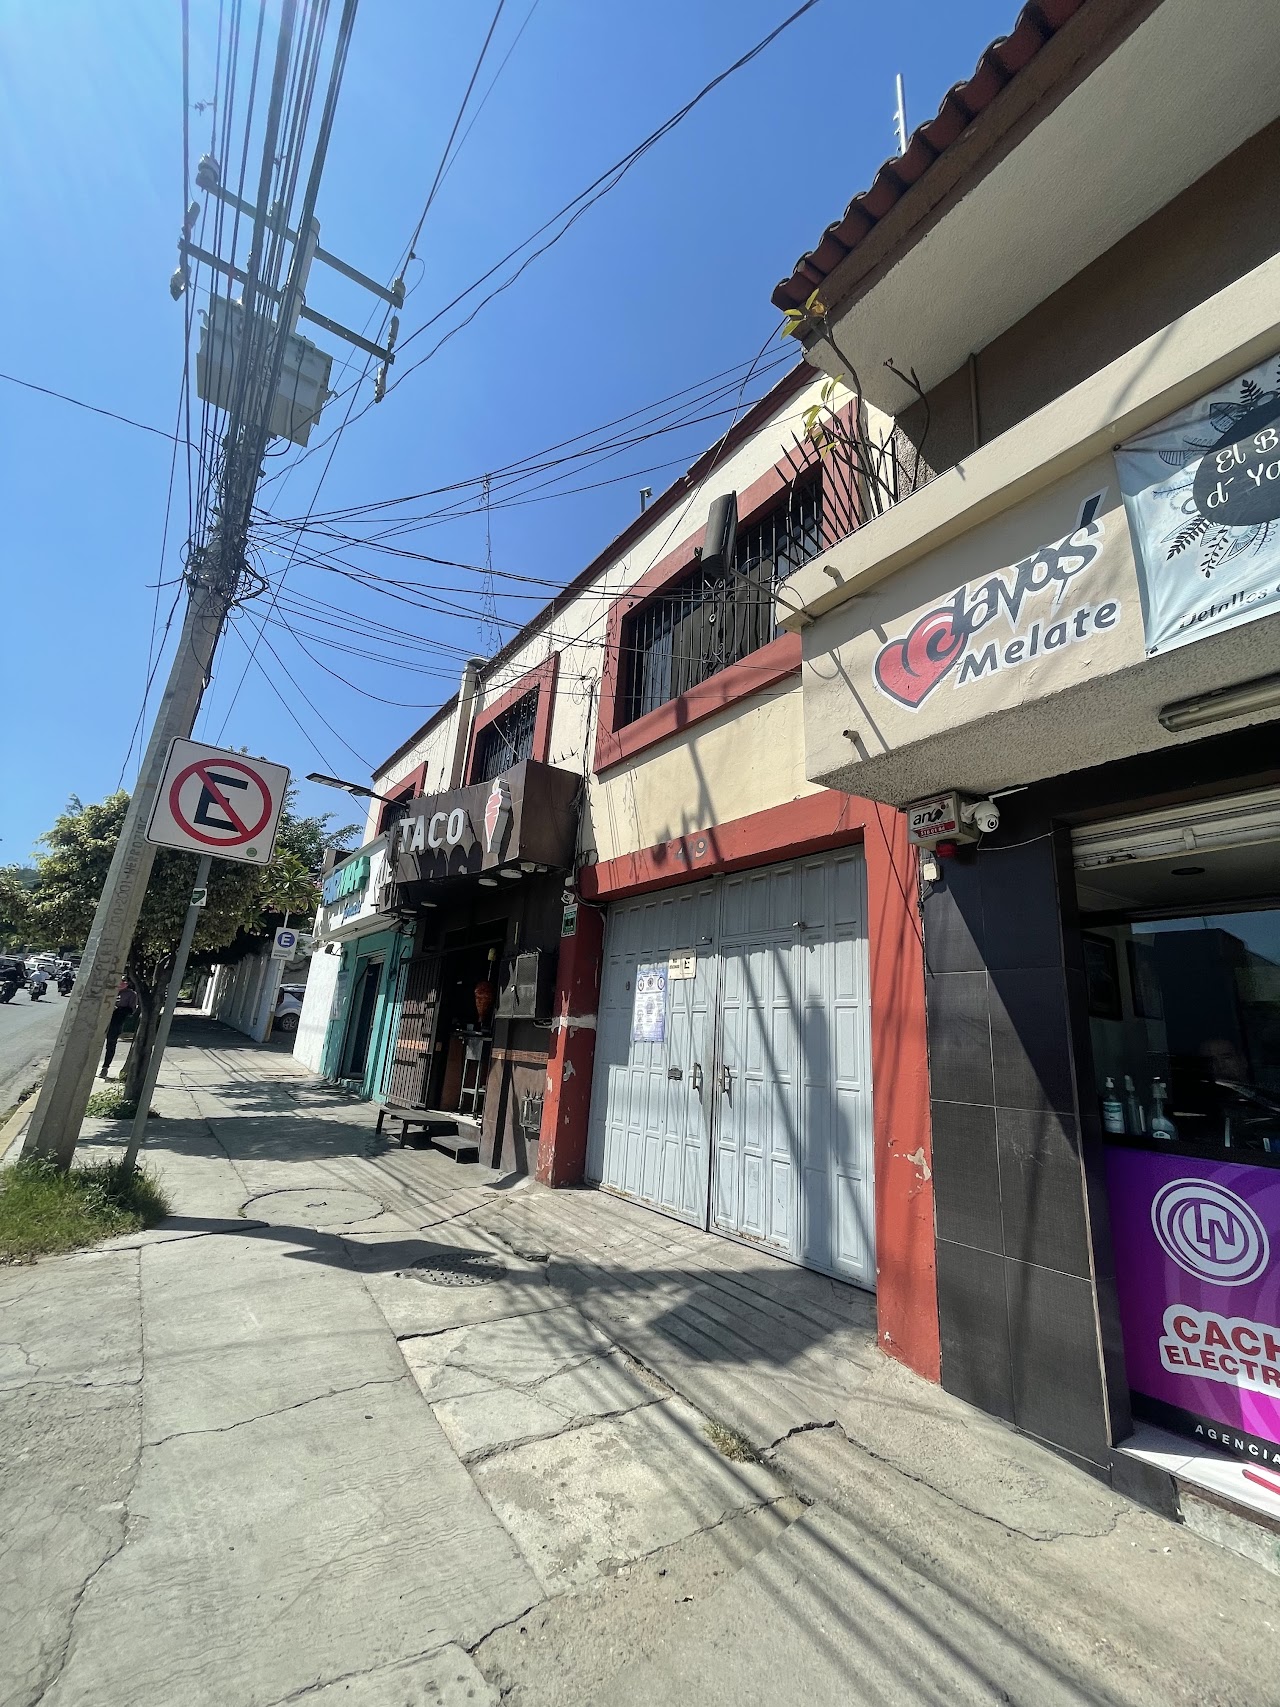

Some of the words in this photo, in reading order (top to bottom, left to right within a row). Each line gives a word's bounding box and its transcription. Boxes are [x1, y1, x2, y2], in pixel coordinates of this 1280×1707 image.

[1215, 443, 1246, 473] El
[957, 602, 1118, 685] Melate
[399, 807, 465, 854] TACO
[280, 933, 292, 946] E
[1164, 1344, 1280, 1389] ELECTR
